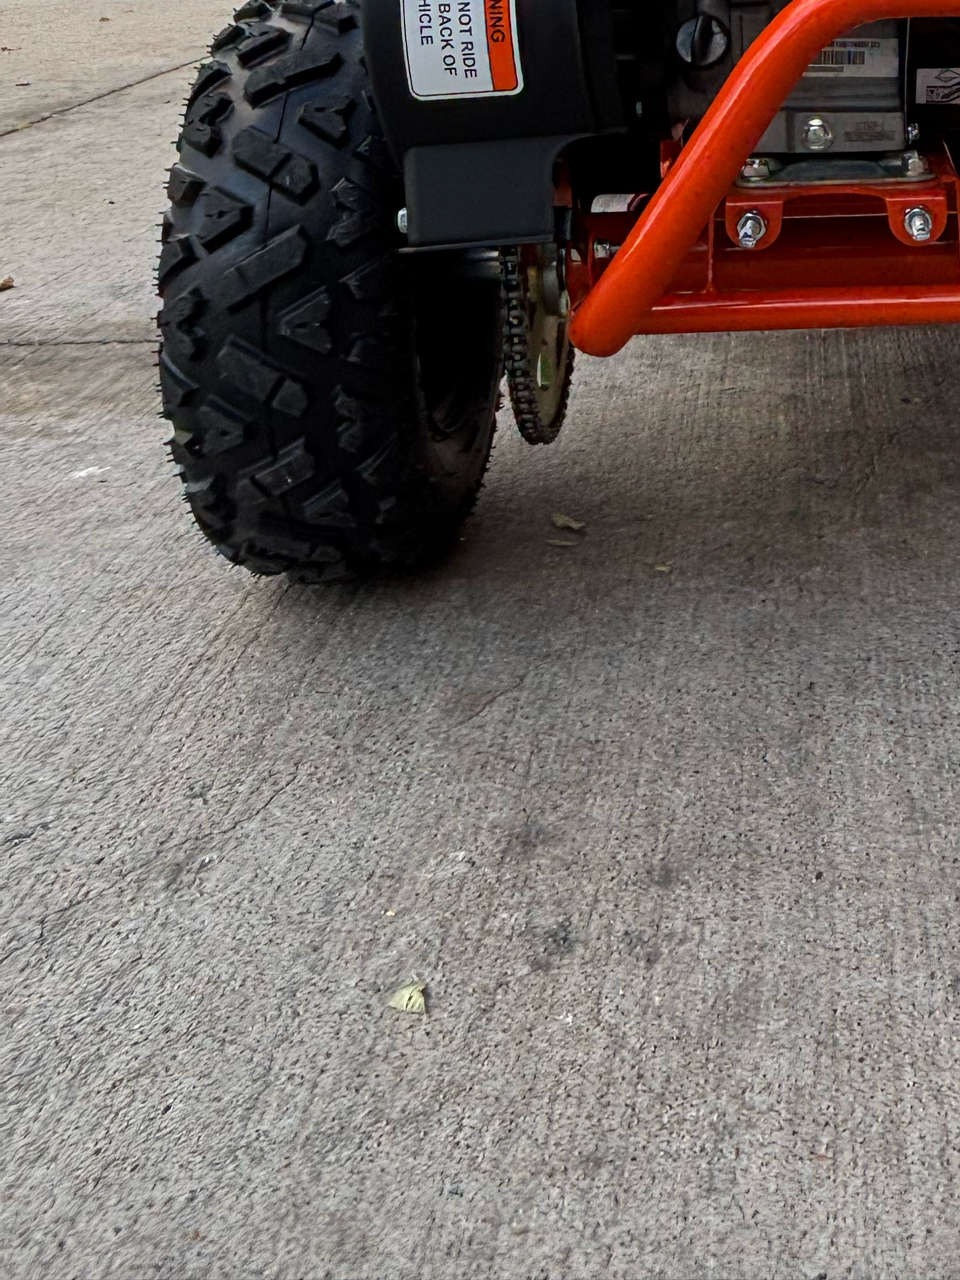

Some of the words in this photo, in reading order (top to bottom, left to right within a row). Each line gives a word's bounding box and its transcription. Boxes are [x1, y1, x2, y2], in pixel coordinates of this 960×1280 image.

[438, 3, 454, 51] BACK
[457, 2, 473, 36] NOT
[443, 55, 457, 77] OF
[460, 41, 478, 79] RIDE
